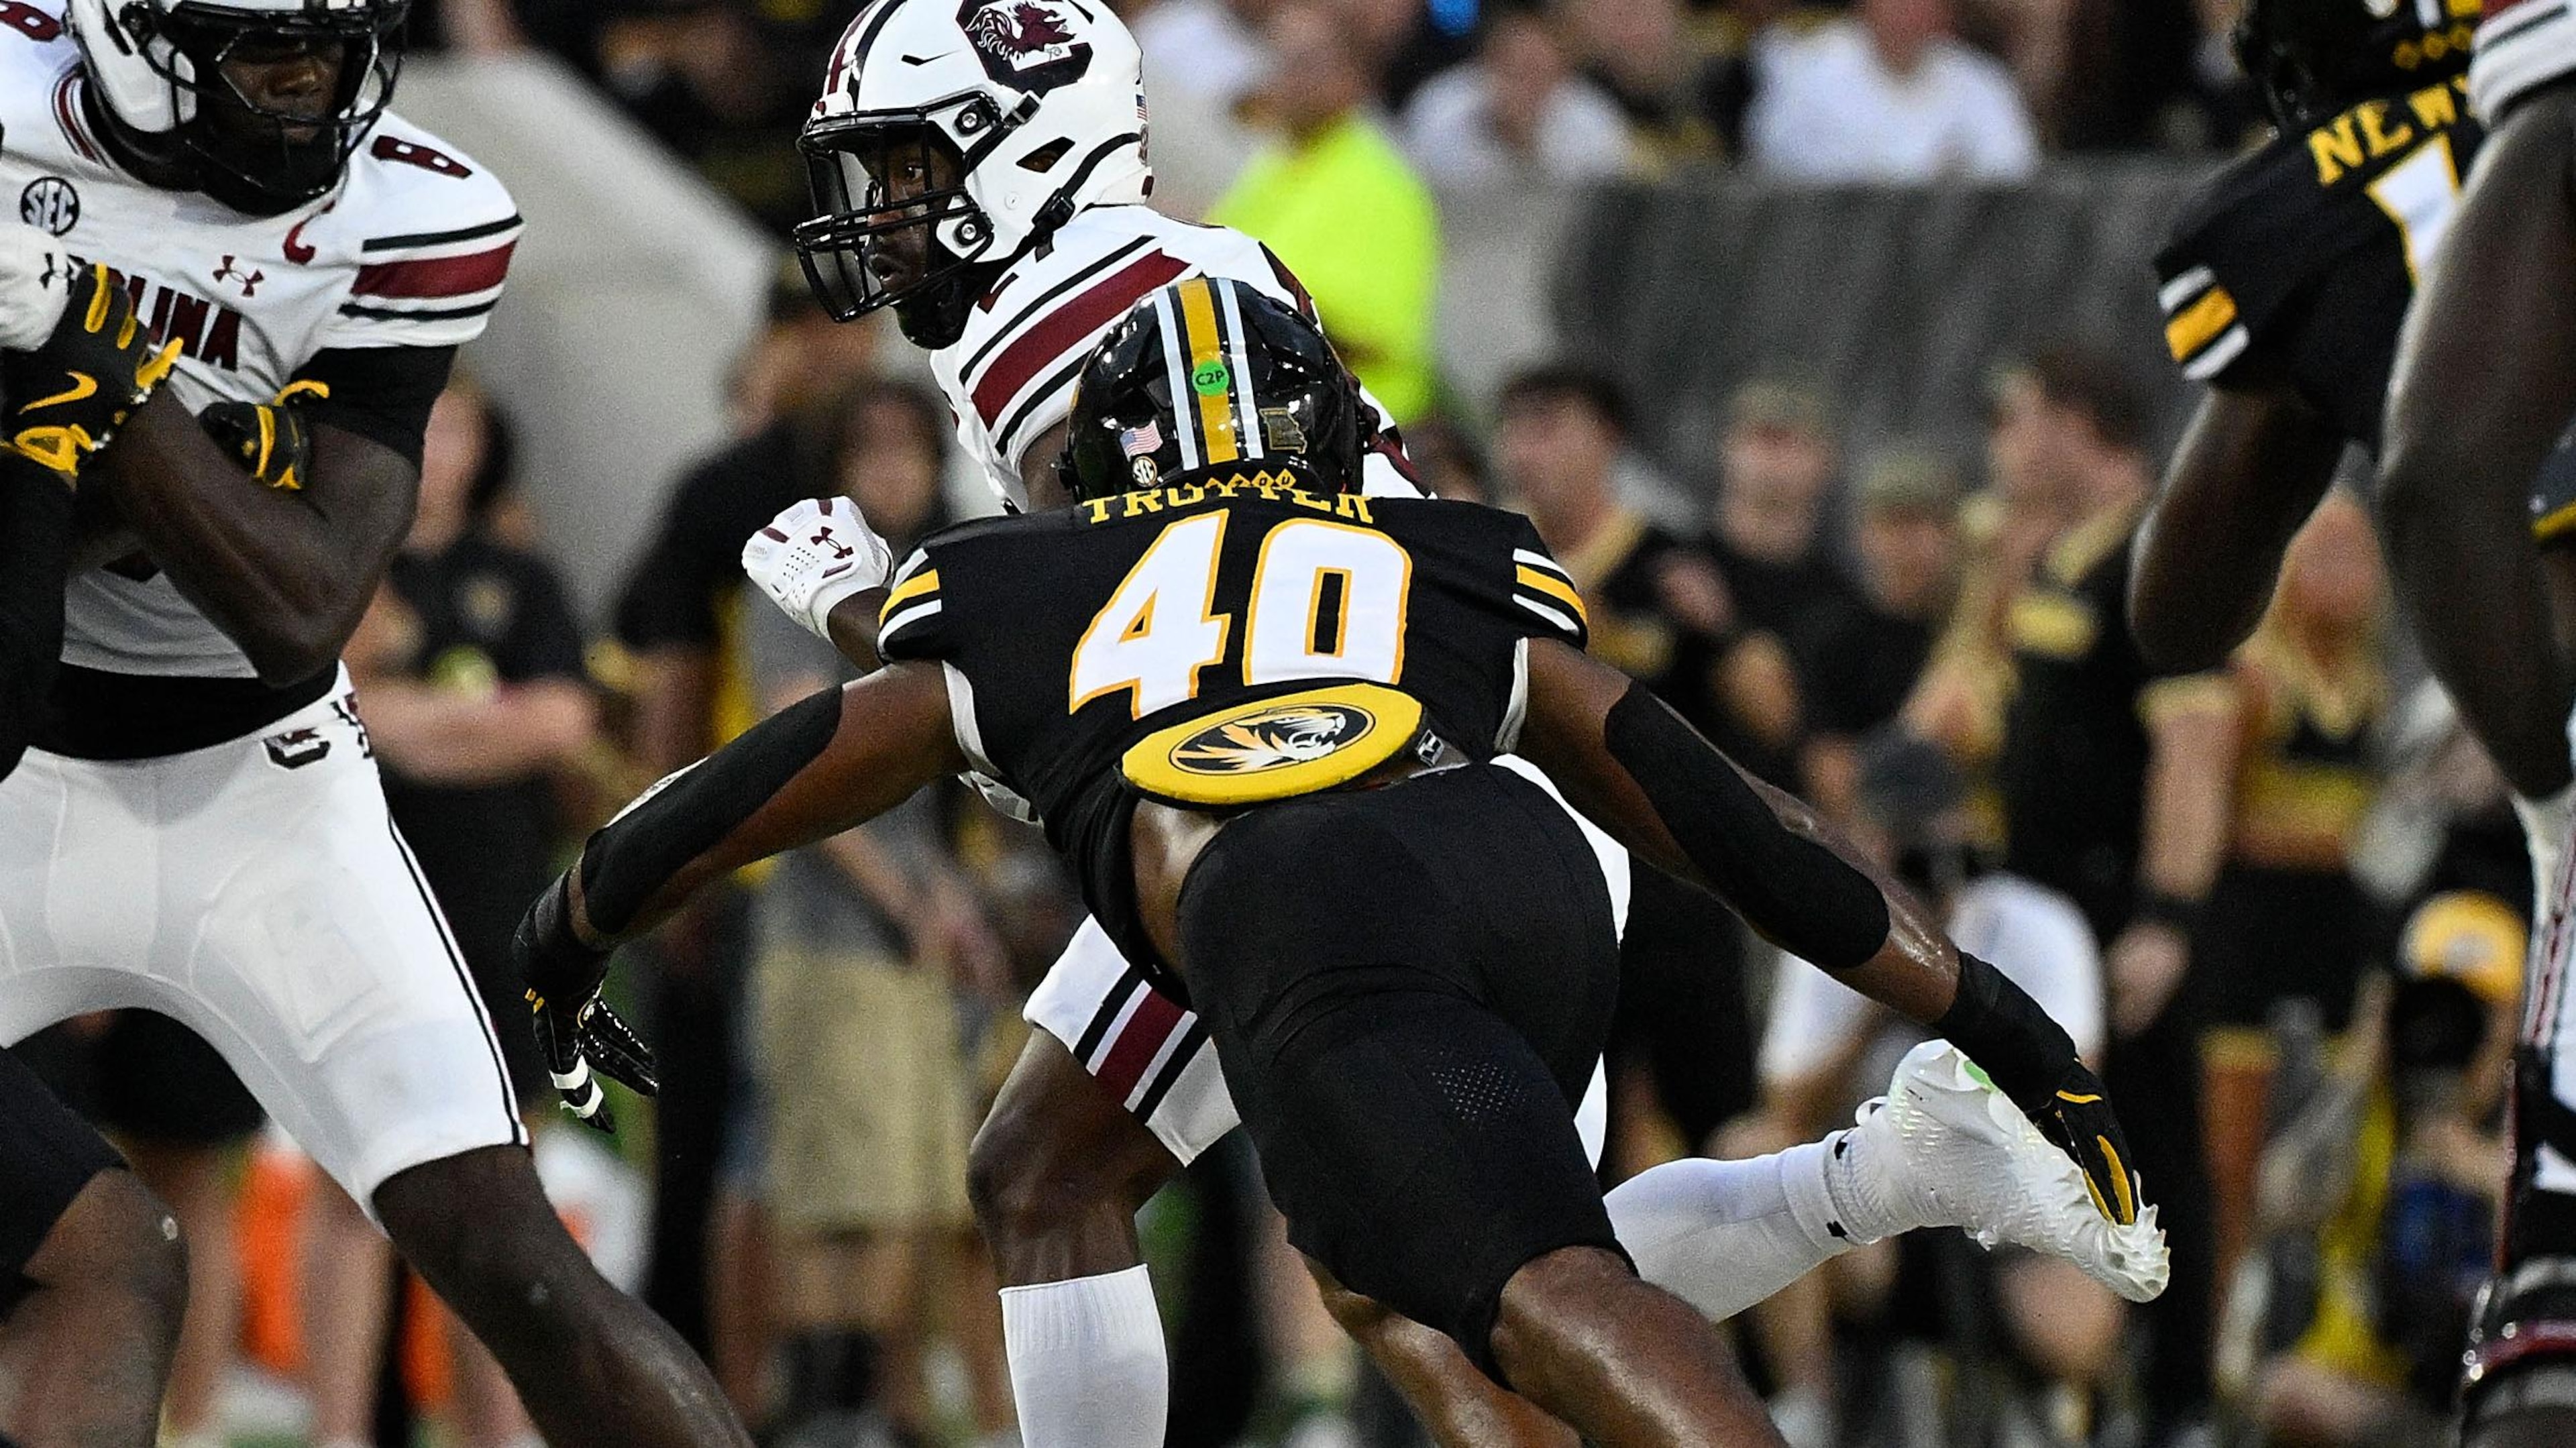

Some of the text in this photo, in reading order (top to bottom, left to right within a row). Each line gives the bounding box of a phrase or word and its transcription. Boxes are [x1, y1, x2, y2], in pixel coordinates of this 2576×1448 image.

[2308, 73, 2477, 186] NEW
[372, 135, 473, 179] 8
[25, 180, 75, 233] SEC
[1195, 370, 1226, 386] C2P
[1069, 508, 1413, 720] 40
